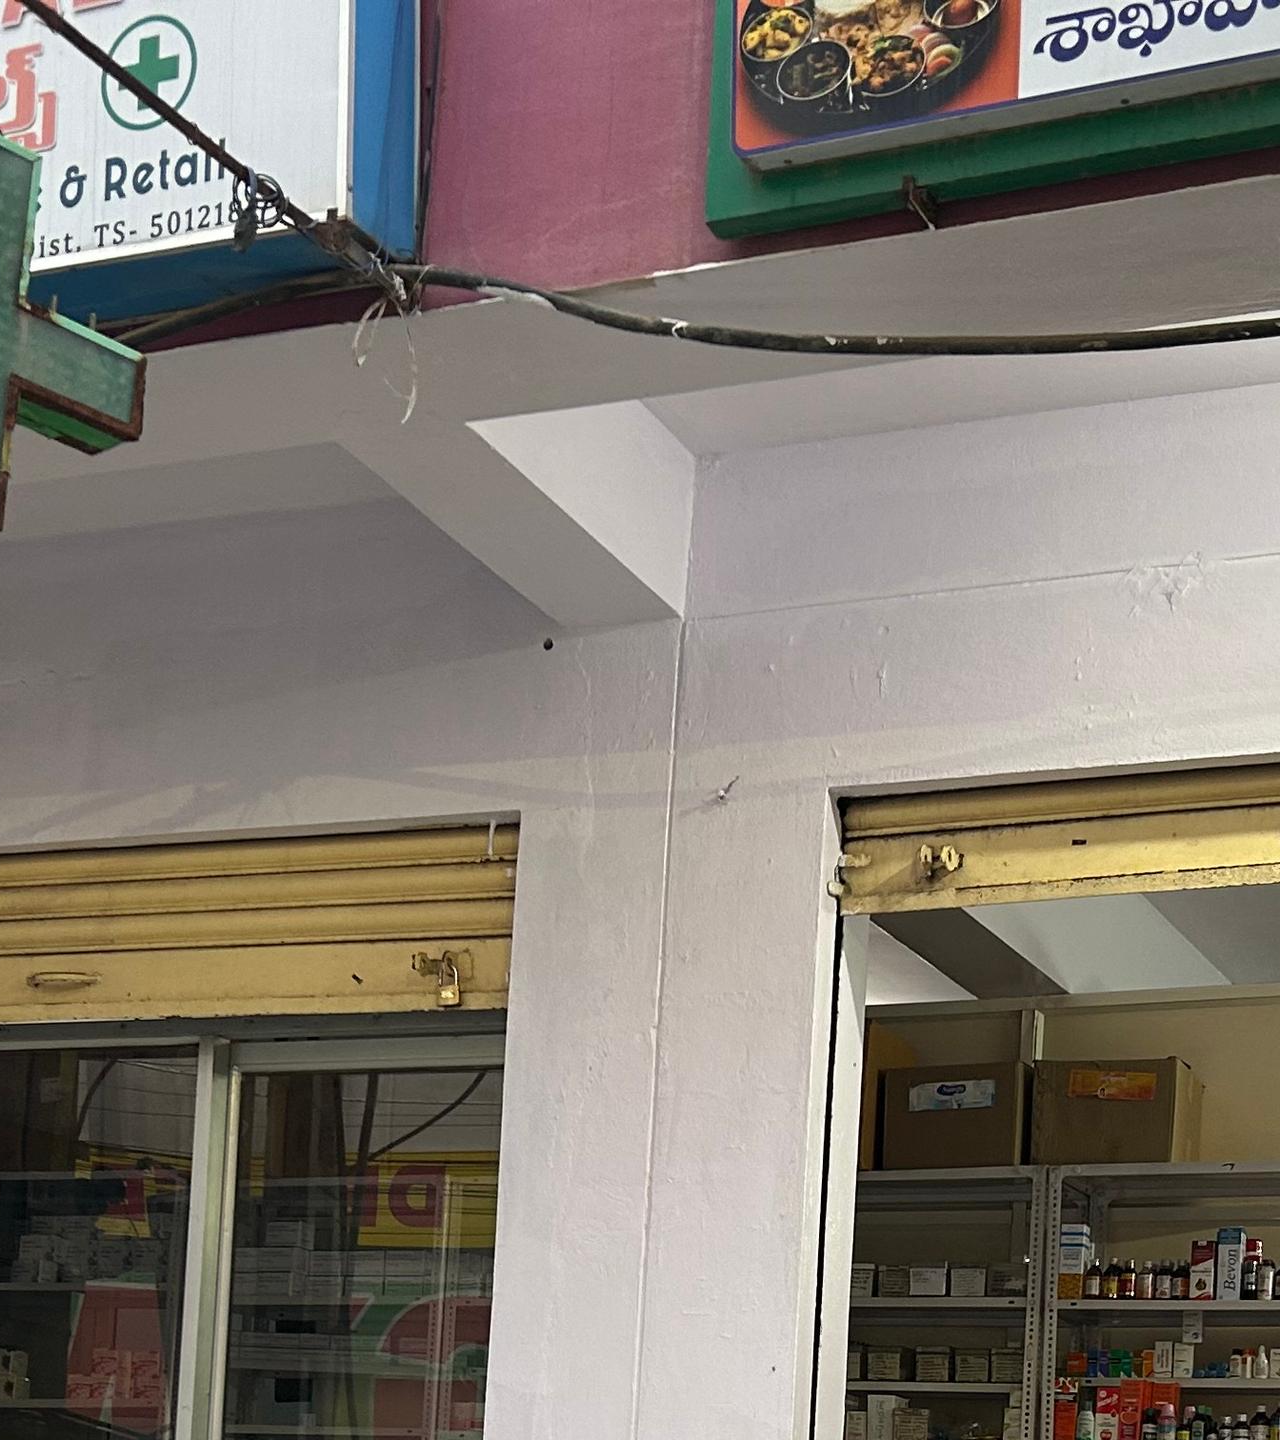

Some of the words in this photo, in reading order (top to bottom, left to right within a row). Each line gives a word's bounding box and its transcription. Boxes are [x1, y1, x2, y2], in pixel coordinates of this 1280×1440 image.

[60, 165, 88, 208] &
[95, 220, 138, 250] TS-
[150, 199, 240, 239] 501218
[1223, 1249, 1237, 1291] Bevon
